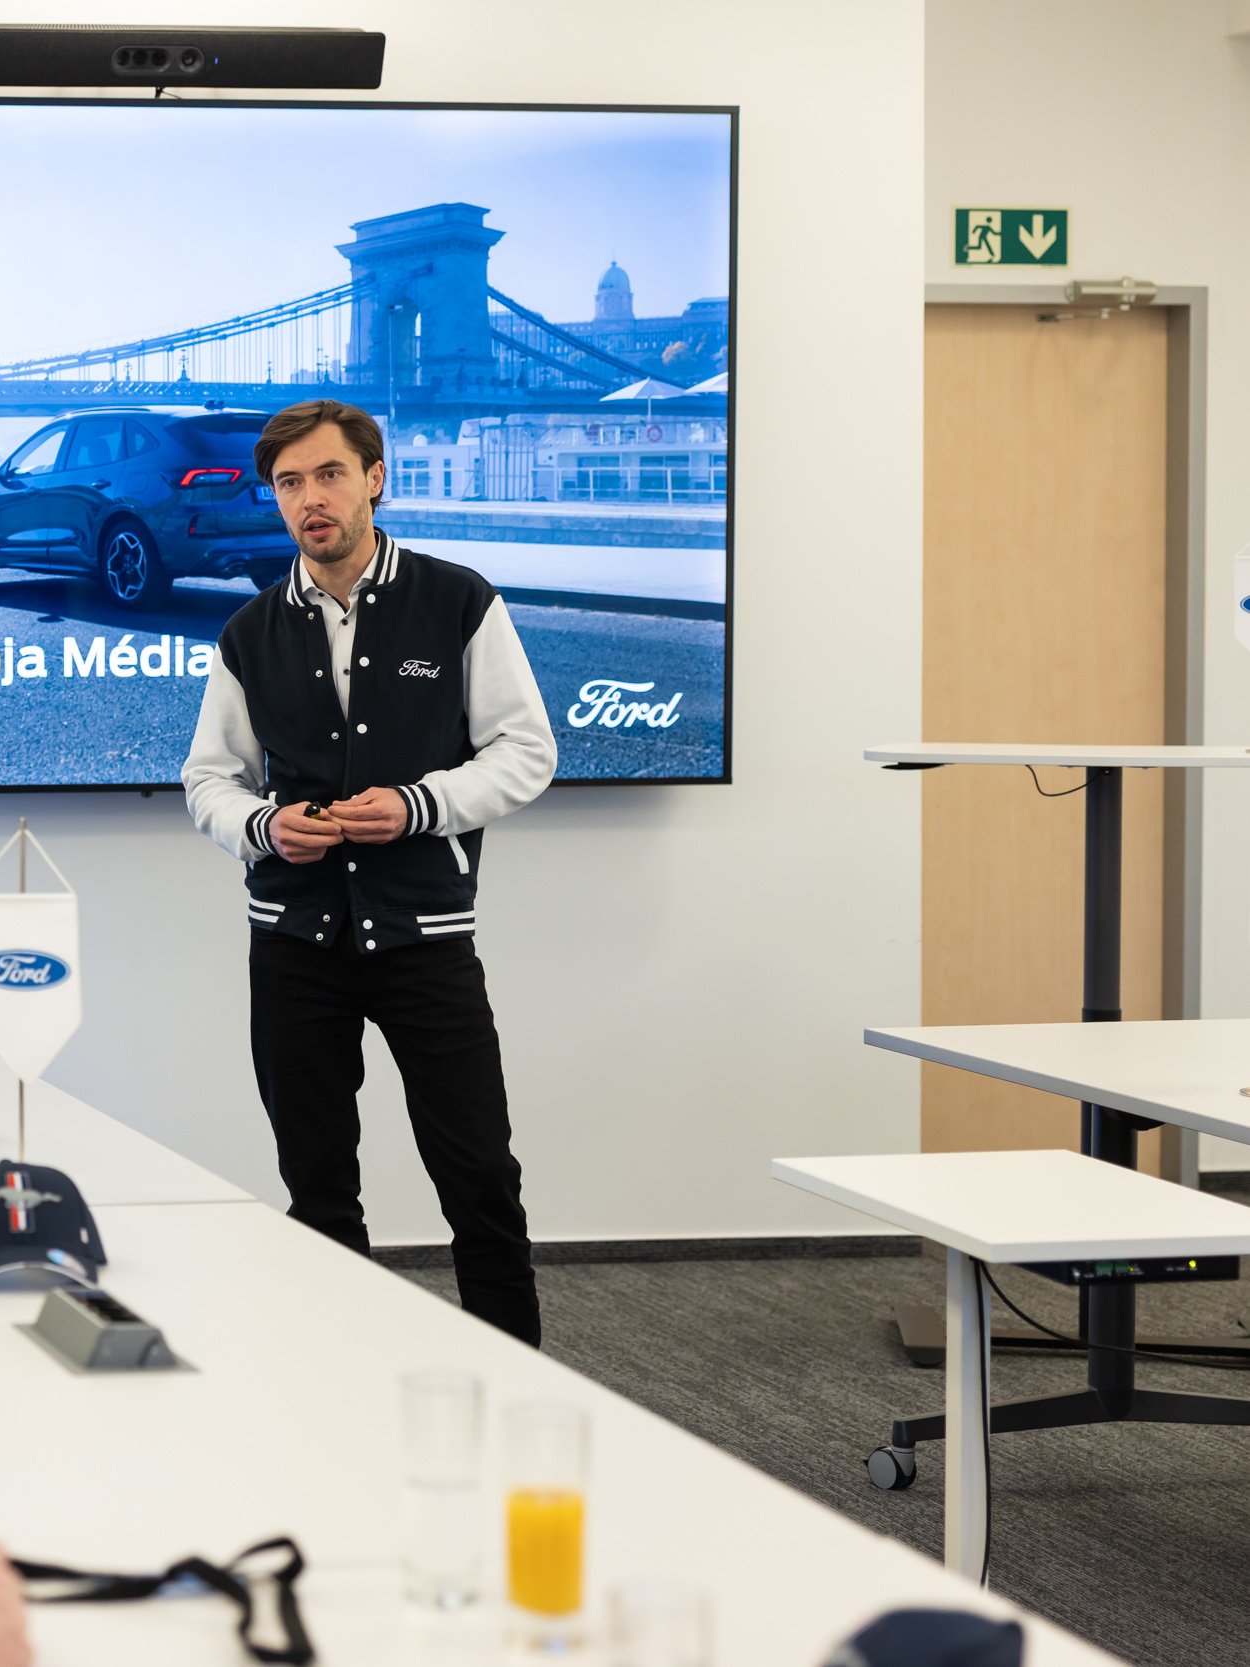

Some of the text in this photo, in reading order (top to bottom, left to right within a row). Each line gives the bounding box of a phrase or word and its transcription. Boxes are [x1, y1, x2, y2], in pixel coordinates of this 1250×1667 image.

[63, 634, 216, 678] Média
[398, 659, 441, 679] Ford
[567, 679, 683, 728] Ford
